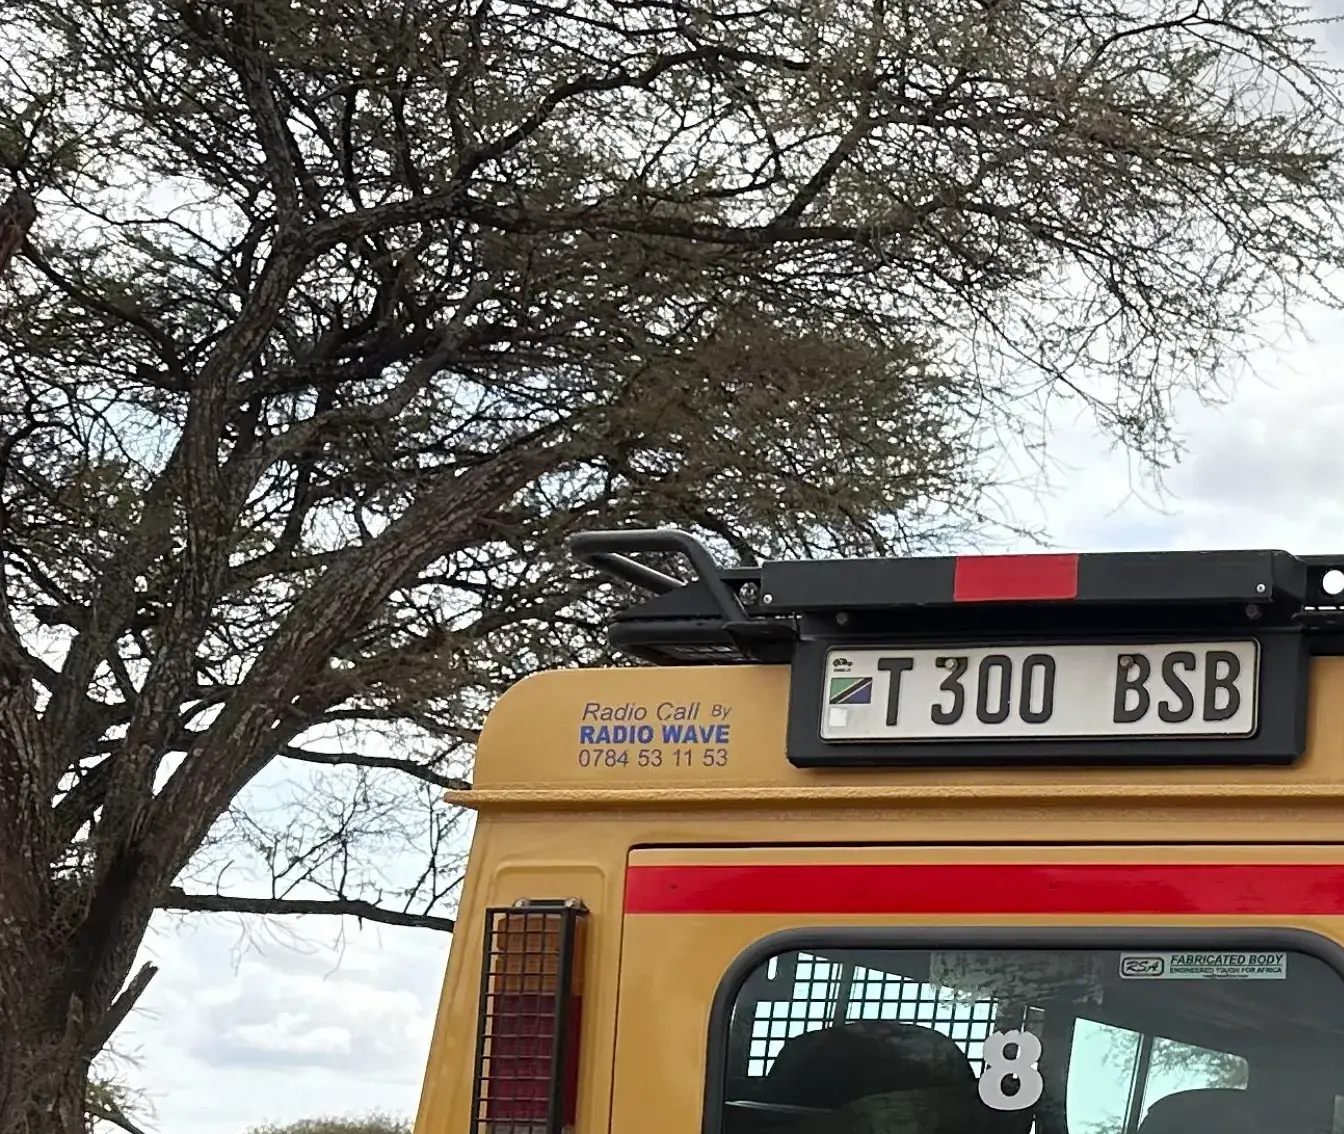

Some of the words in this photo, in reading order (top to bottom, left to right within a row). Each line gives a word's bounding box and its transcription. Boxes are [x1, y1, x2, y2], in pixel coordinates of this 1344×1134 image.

[877, 656, 914, 727] T
[930, 653, 1056, 726] 300
[1112, 650, 1242, 724] BSB
[582, 702, 647, 721] Radio
[656, 702, 701, 721] Call
[711, 704, 732, 720] By
[579, 725, 654, 744] RADIO
[661, 724, 730, 744] WAVE
[578, 749, 629, 767] 0784
[638, 749, 662, 767] 53
[673, 749, 692, 767] 11
[702, 749, 728, 767] 53
[1125, 960, 1160, 972] RSA
[1171, 954, 1246, 965] FABRICATED
[1249, 954, 1284, 965] BODY
[978, 1030, 1044, 1111] 8
